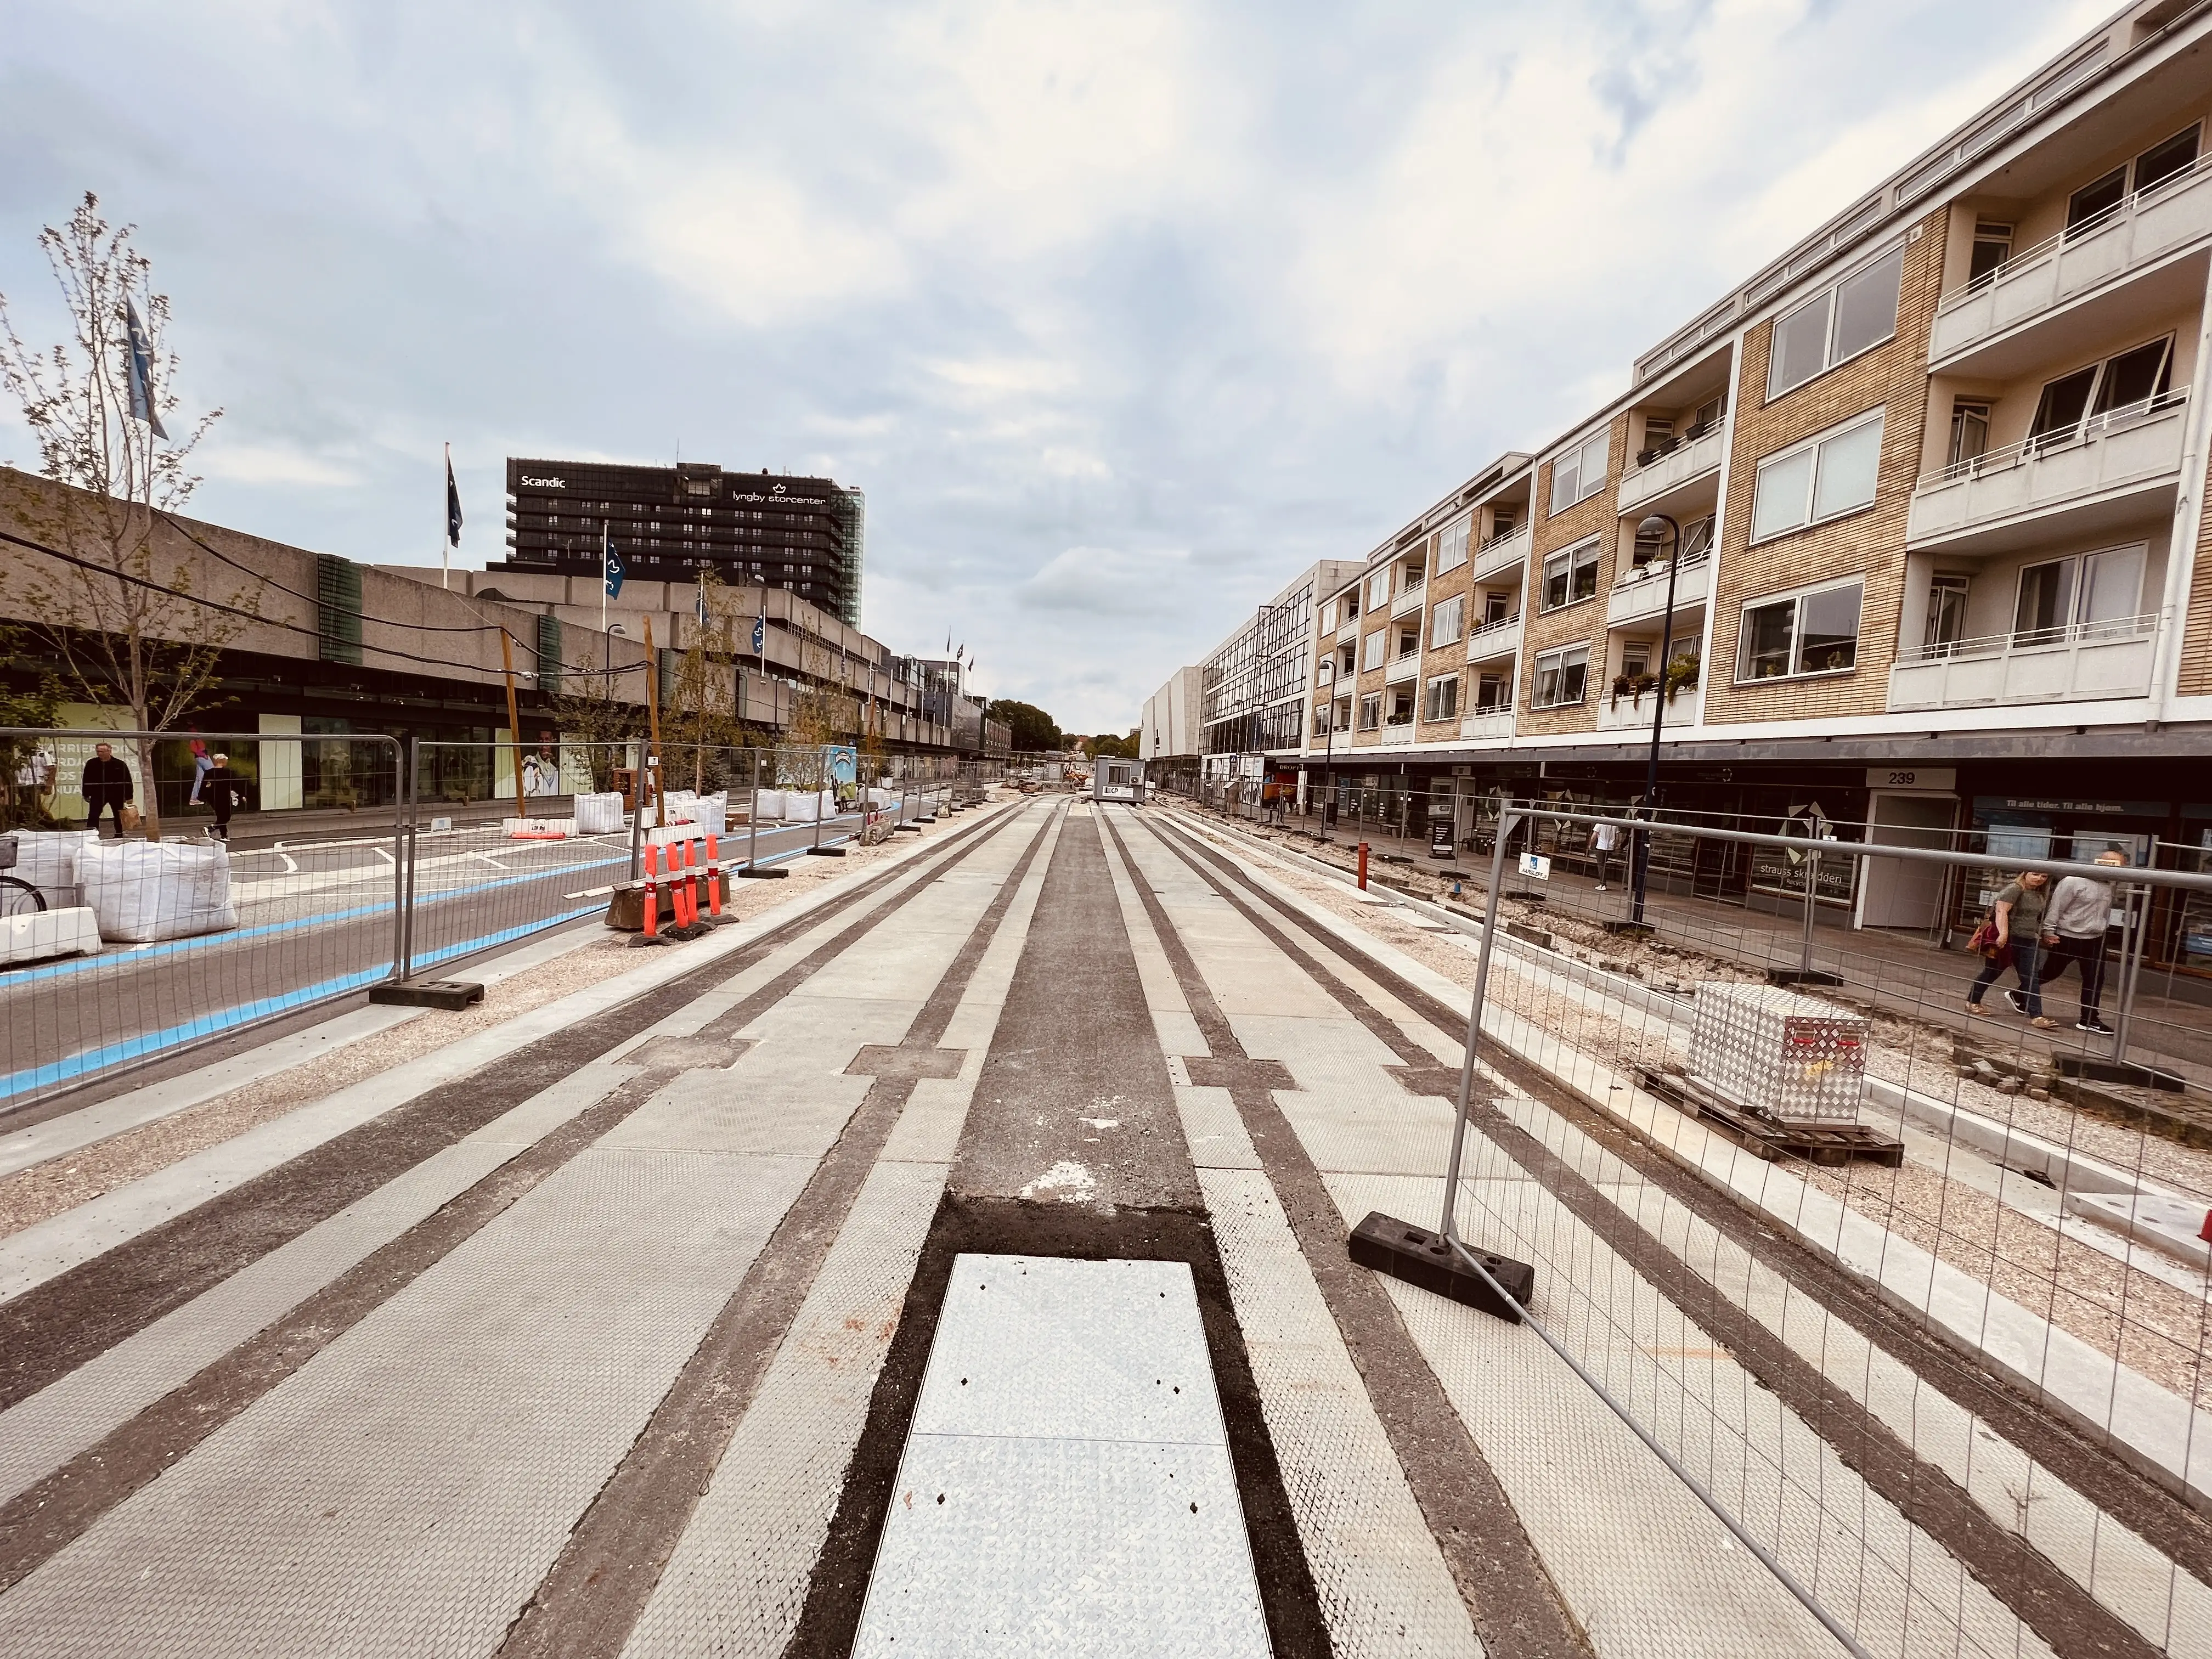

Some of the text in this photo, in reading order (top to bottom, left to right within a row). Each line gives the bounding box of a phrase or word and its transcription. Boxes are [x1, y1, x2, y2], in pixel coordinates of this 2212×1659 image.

[521, 475, 566, 488] Scandic
[733, 490, 826, 505] lyngby storcenter
[1888, 772, 1915, 785] 239
[2096, 803, 2124, 812] hjem.
[1760, 864, 1792, 876] strauss
